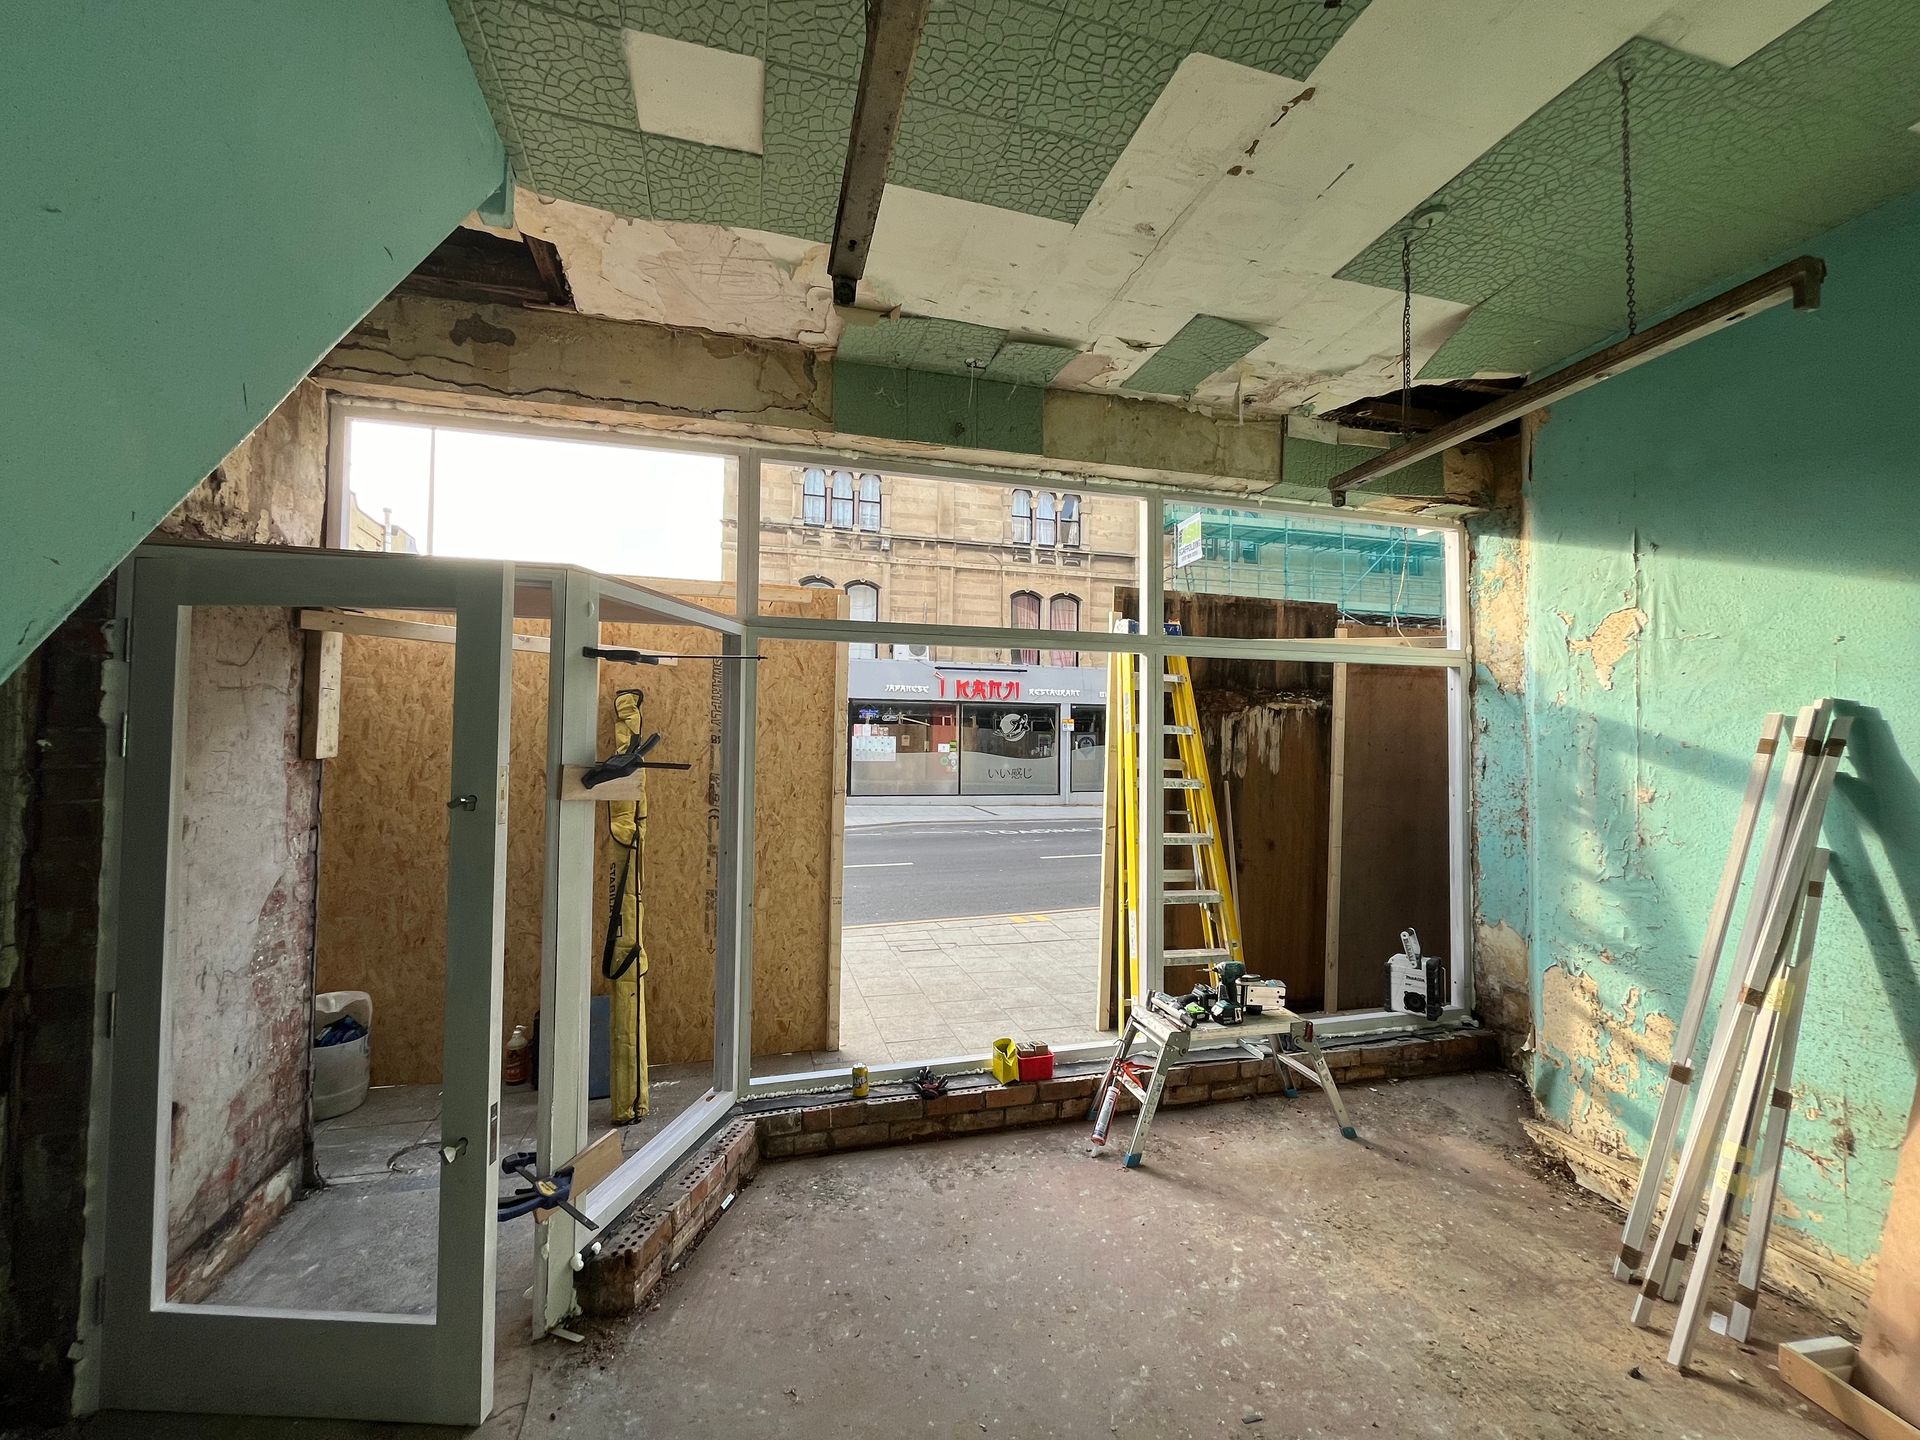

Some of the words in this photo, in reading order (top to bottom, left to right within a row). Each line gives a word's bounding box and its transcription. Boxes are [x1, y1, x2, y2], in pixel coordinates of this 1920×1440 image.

[885, 684, 930, 694] JAPANESE
[1029, 688, 1081, 697] RESTAURANT
[988, 767, 1032, 779] いい感じ
